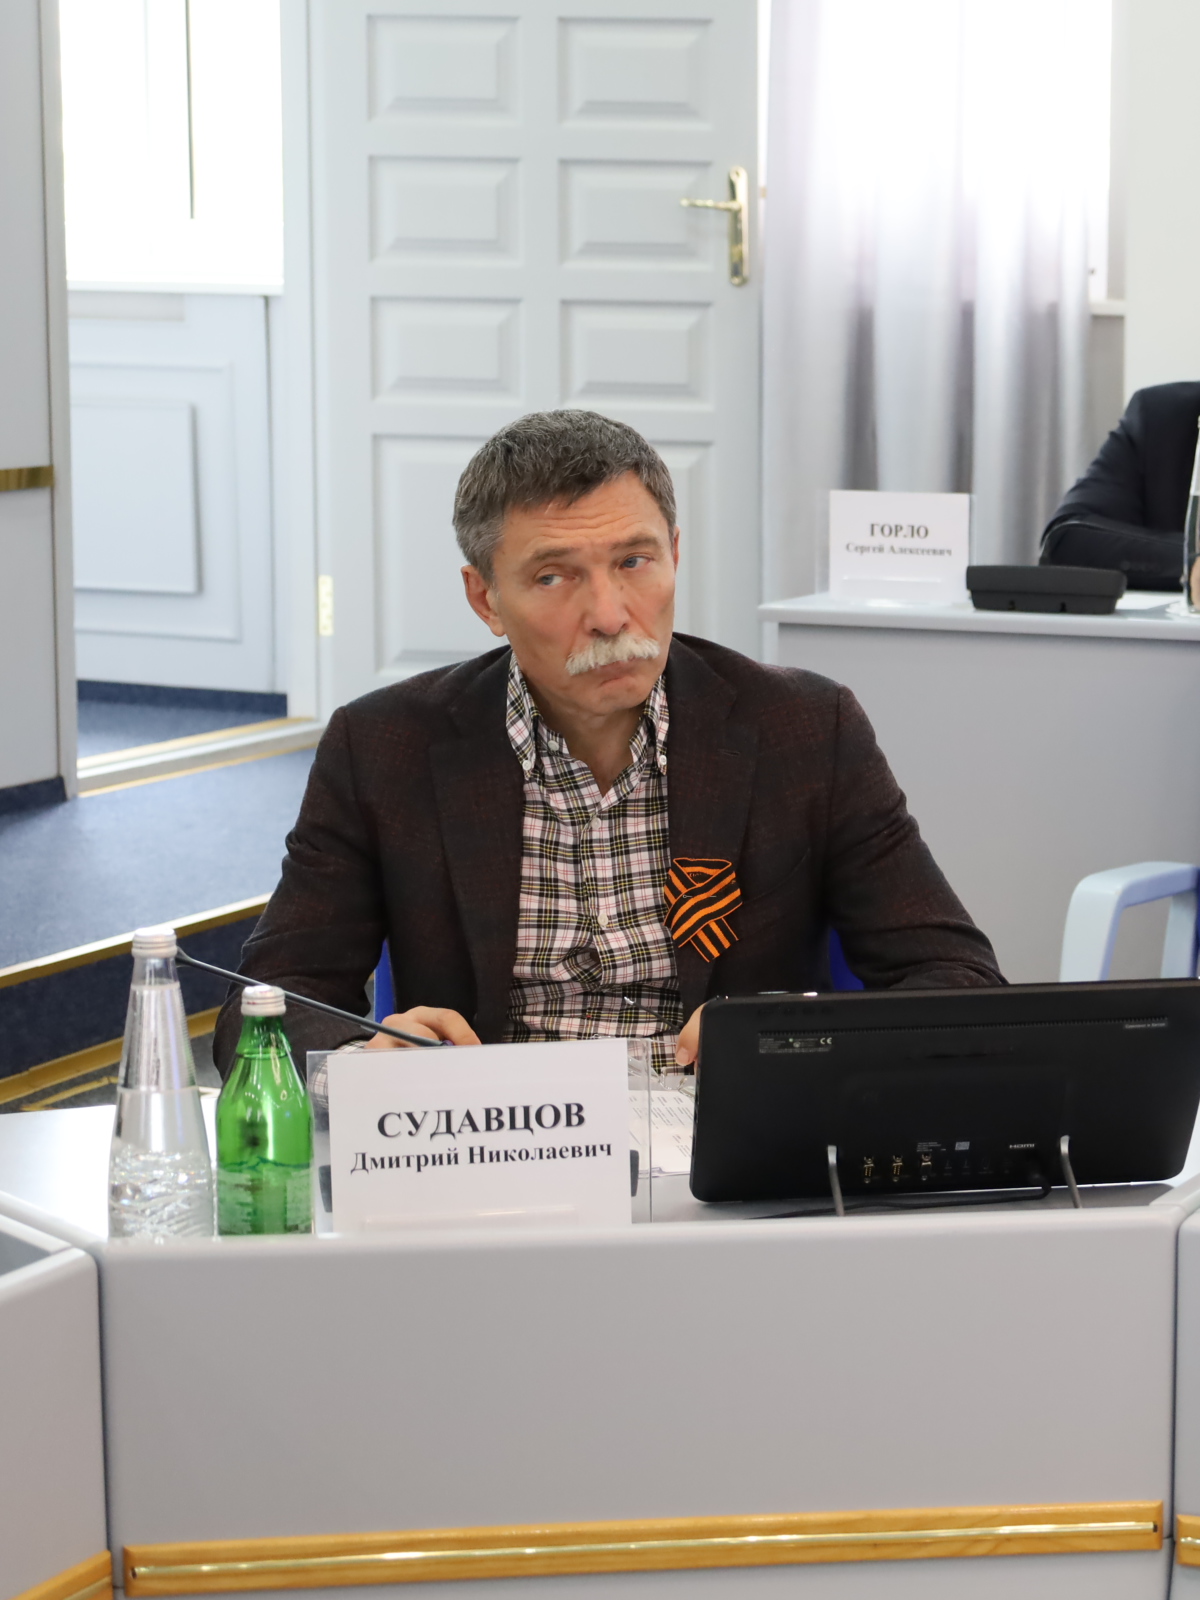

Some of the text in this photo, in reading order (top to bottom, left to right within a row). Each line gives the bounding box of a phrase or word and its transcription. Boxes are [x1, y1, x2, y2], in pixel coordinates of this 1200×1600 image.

[870, 522, 930, 539] ГОРЛО
[845, 542, 952, 556] Сергей Алексеевич
[377, 1102, 586, 1141] СУДАВЦОВ
[350, 1143, 612, 1174] Дмитрий Николаевич
